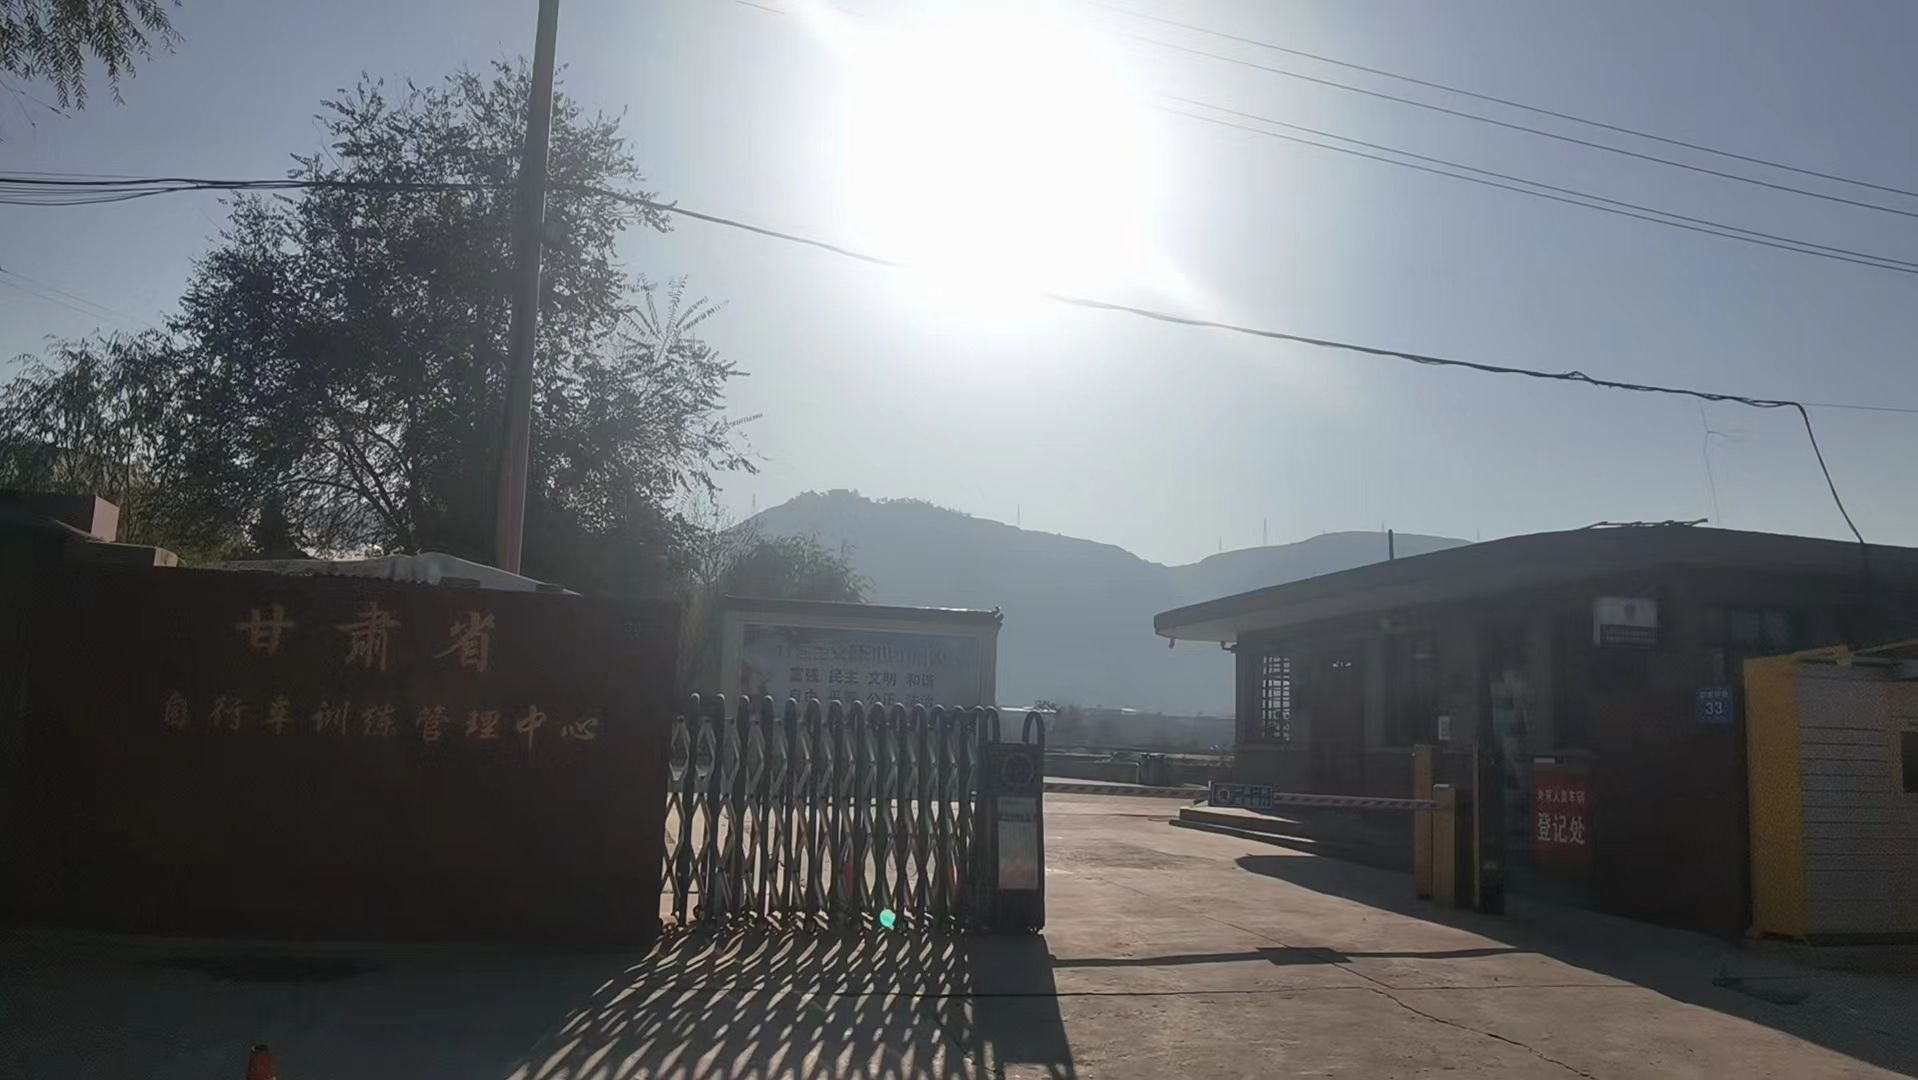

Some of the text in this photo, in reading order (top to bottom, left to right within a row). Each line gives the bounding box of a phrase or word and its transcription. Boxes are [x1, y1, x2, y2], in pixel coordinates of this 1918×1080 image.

[234, 601, 496, 672] 甘肃省
[829, 668, 859, 684] 民主
[868, 671, 897, 687] 文明
[906, 672, 937, 688] 和谐
[1705, 701, 1724, 715] 33
[1537, 812, 1586, 845] 登记处
